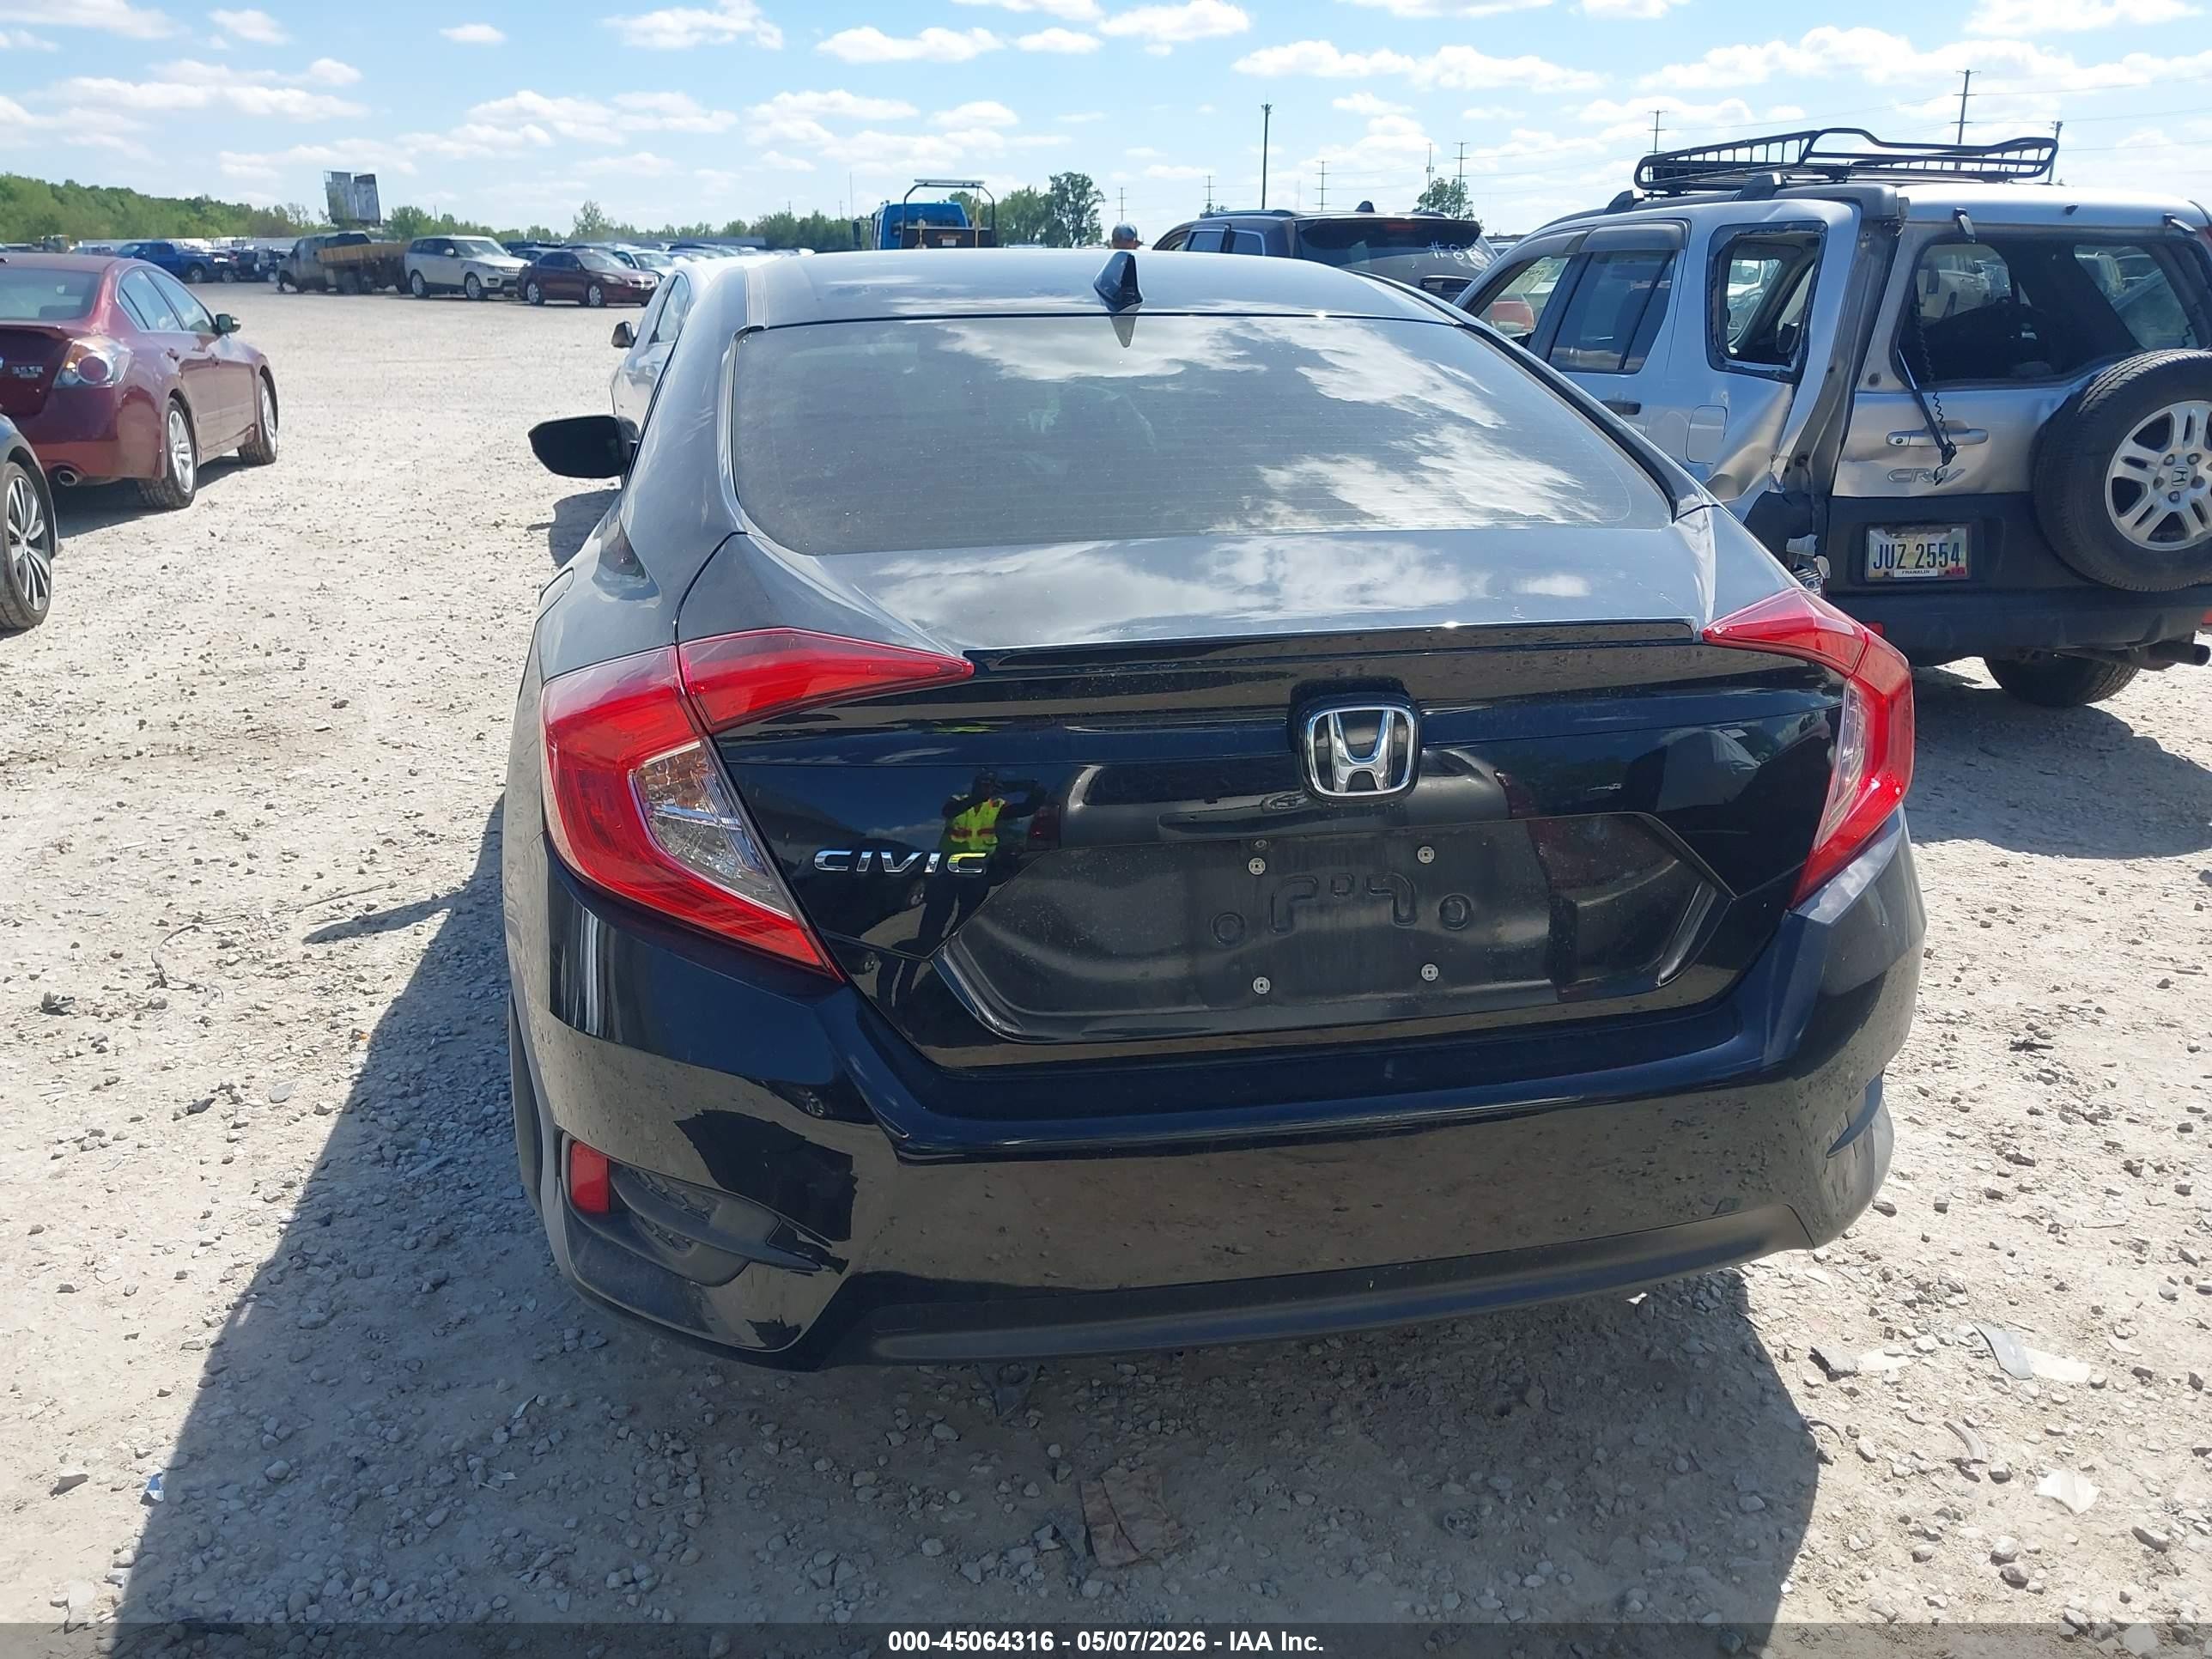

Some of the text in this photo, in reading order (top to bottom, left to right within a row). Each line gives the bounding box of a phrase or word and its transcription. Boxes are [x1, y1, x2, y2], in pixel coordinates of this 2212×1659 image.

[1873, 542, 1960, 569] JUZ 2554
[814, 849, 988, 873] CIVIC
